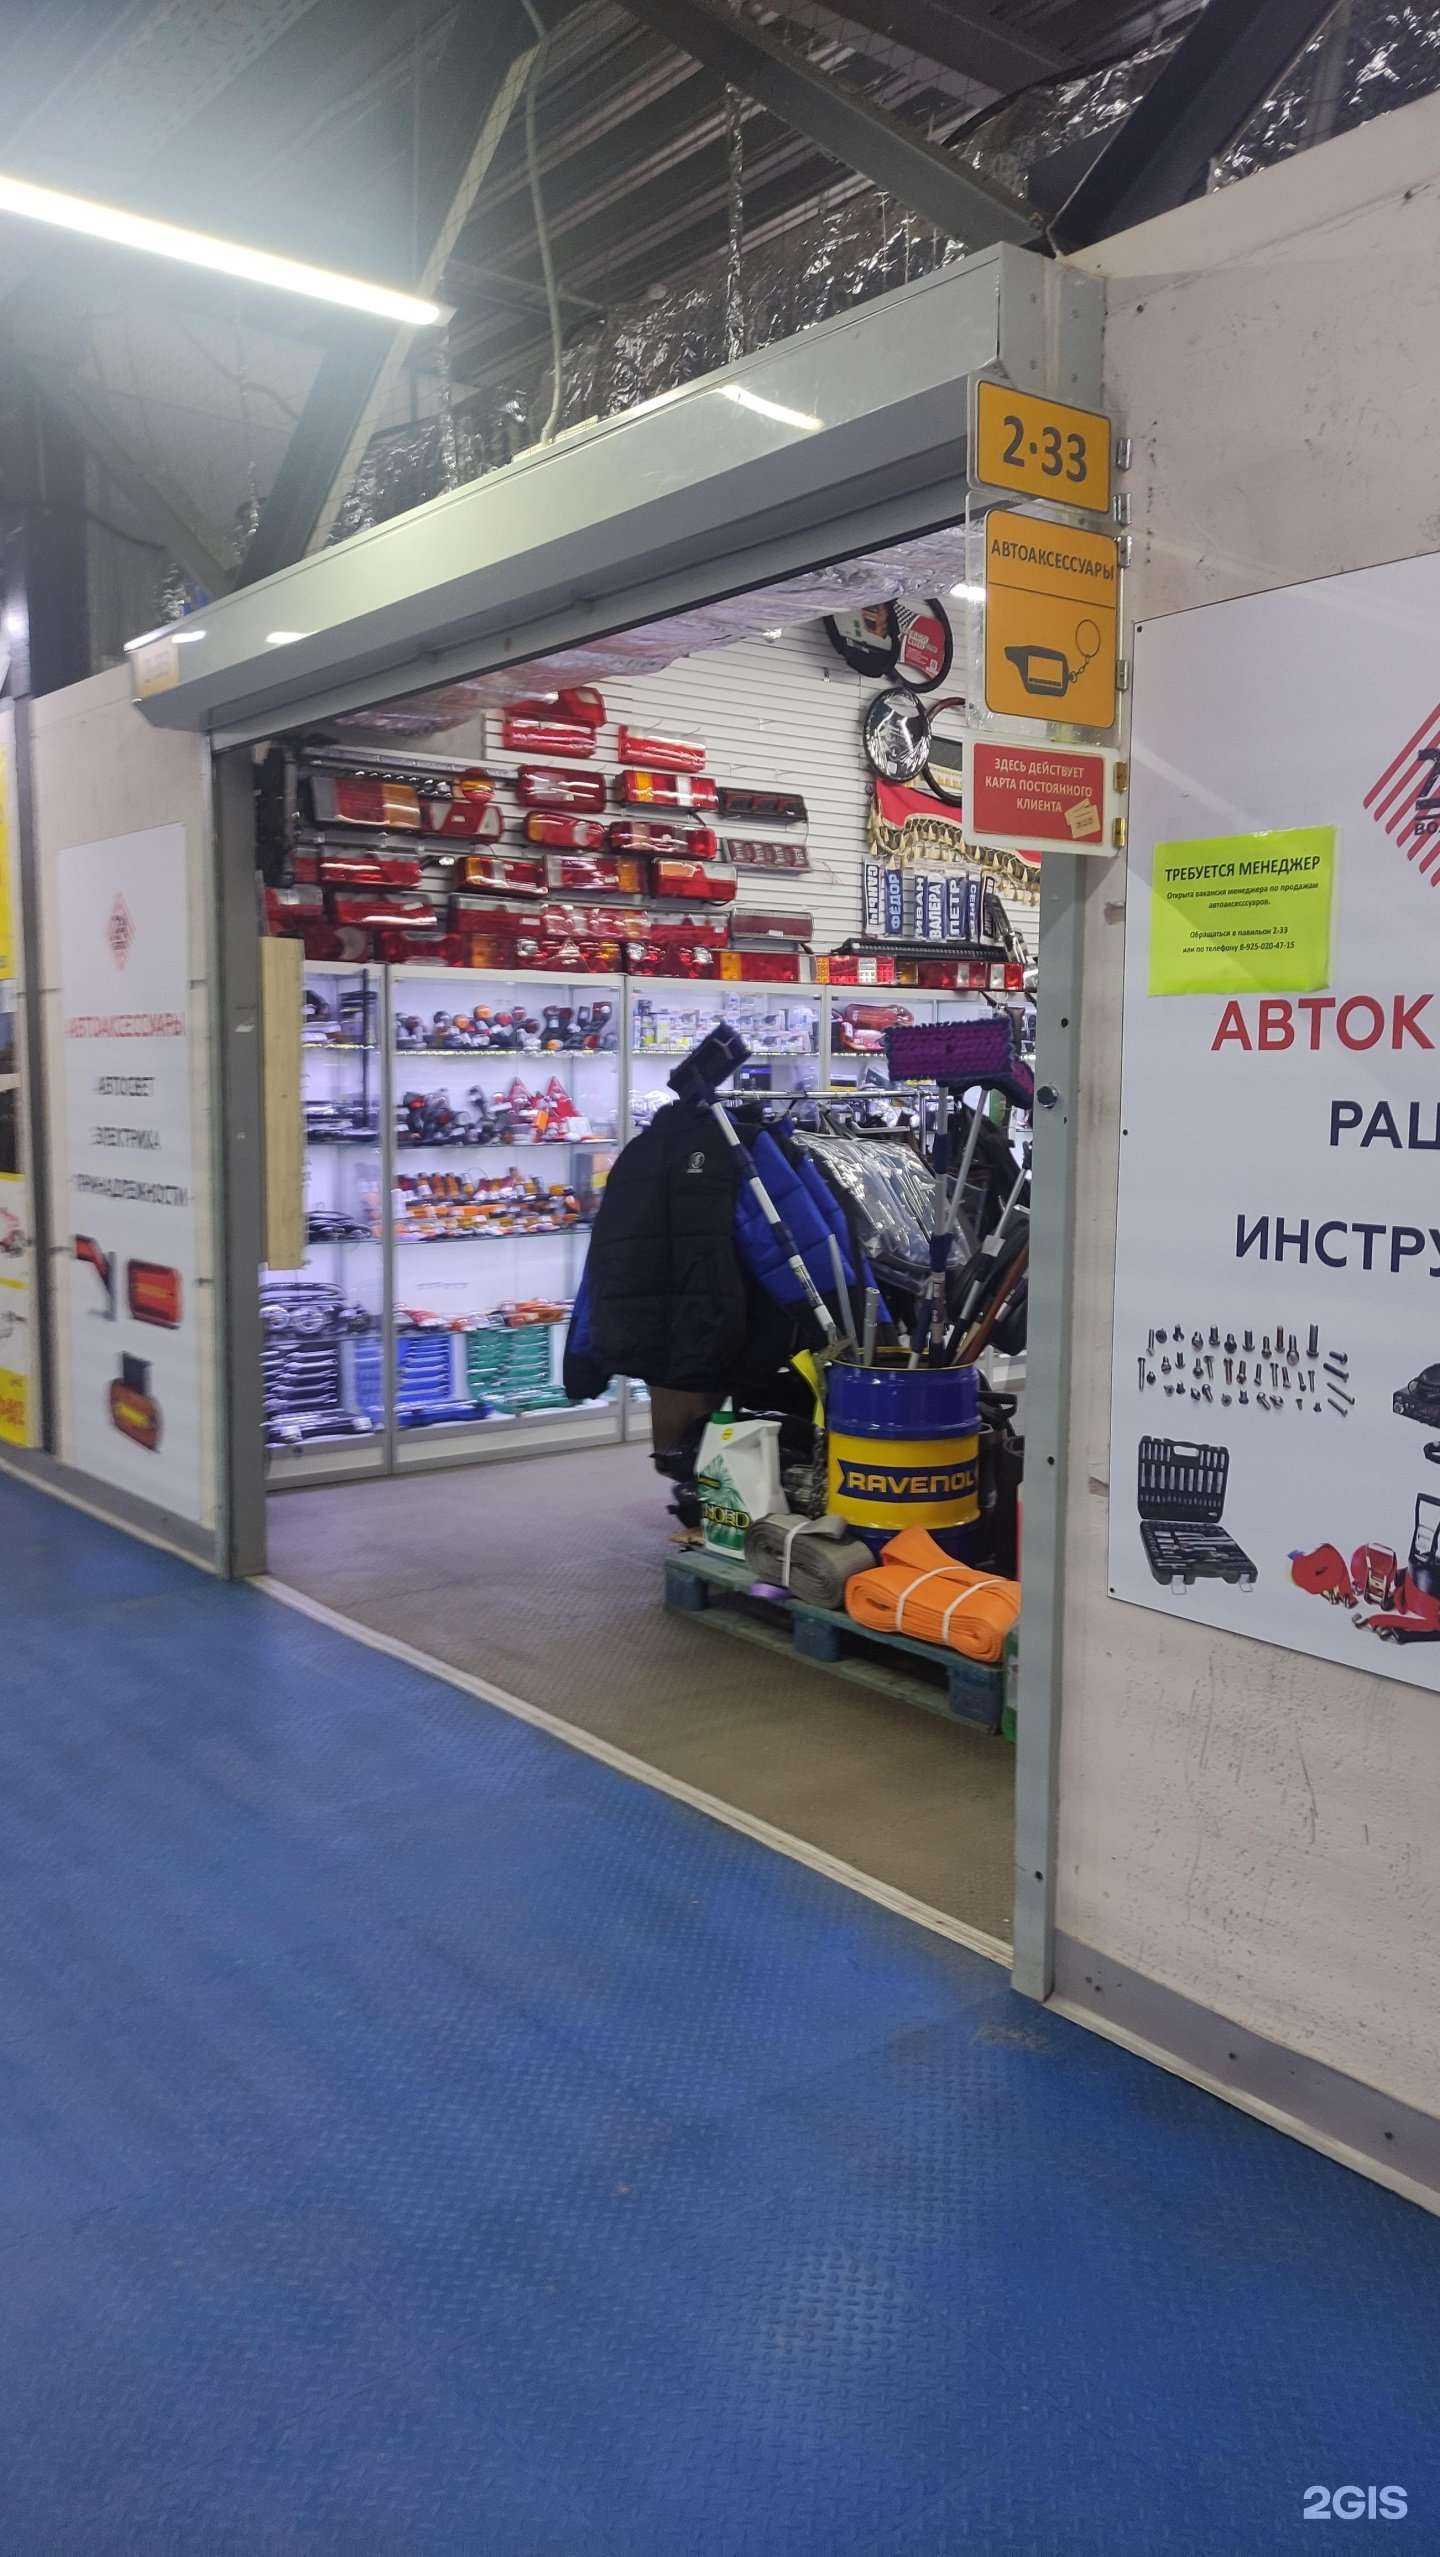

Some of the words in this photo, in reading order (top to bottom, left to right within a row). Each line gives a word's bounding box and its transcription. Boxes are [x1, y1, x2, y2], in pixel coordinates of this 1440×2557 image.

[991, 538, 1114, 582] АВТОАКСЕССУАРЫ
[994, 758, 1027, 773] ЗДЕСЬ
[1028, 762, 1085, 779] ДЕЙСТВУЕТ
[985, 775, 1017, 790] КАРТА
[1019, 779, 1093, 798] ПОСТОЯННОГО
[1016, 798, 1062, 813] КЛИЕНТА
[1165, 863, 1235, 882] ТРЕБУЕТСЯ
[1239, 855, 1321, 876] МЕНЕДЖЕР
[1166, 891, 1194, 900] Открыта
[928, 881, 942, 940] ВАЛЕРА
[1211, 994, 1436, 1051] АВТОК
[848, 1471, 974, 1494] RAVENOL
